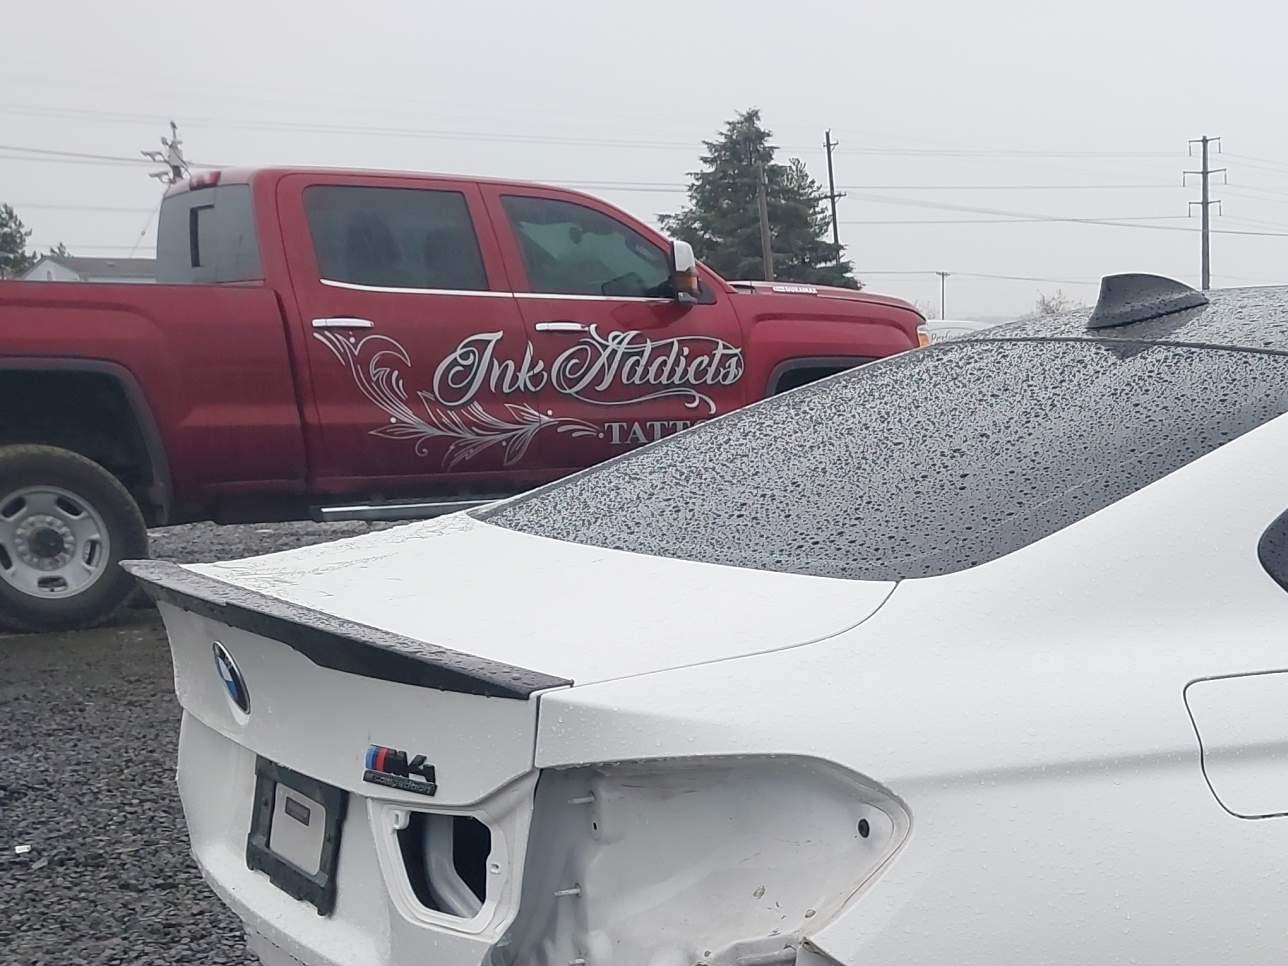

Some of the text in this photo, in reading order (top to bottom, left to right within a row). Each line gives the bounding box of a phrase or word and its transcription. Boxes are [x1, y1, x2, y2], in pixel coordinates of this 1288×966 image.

[432, 323, 744, 415] Ink Addicts
[604, 419, 706, 446] TATT
[368, 744, 436, 784] M4
